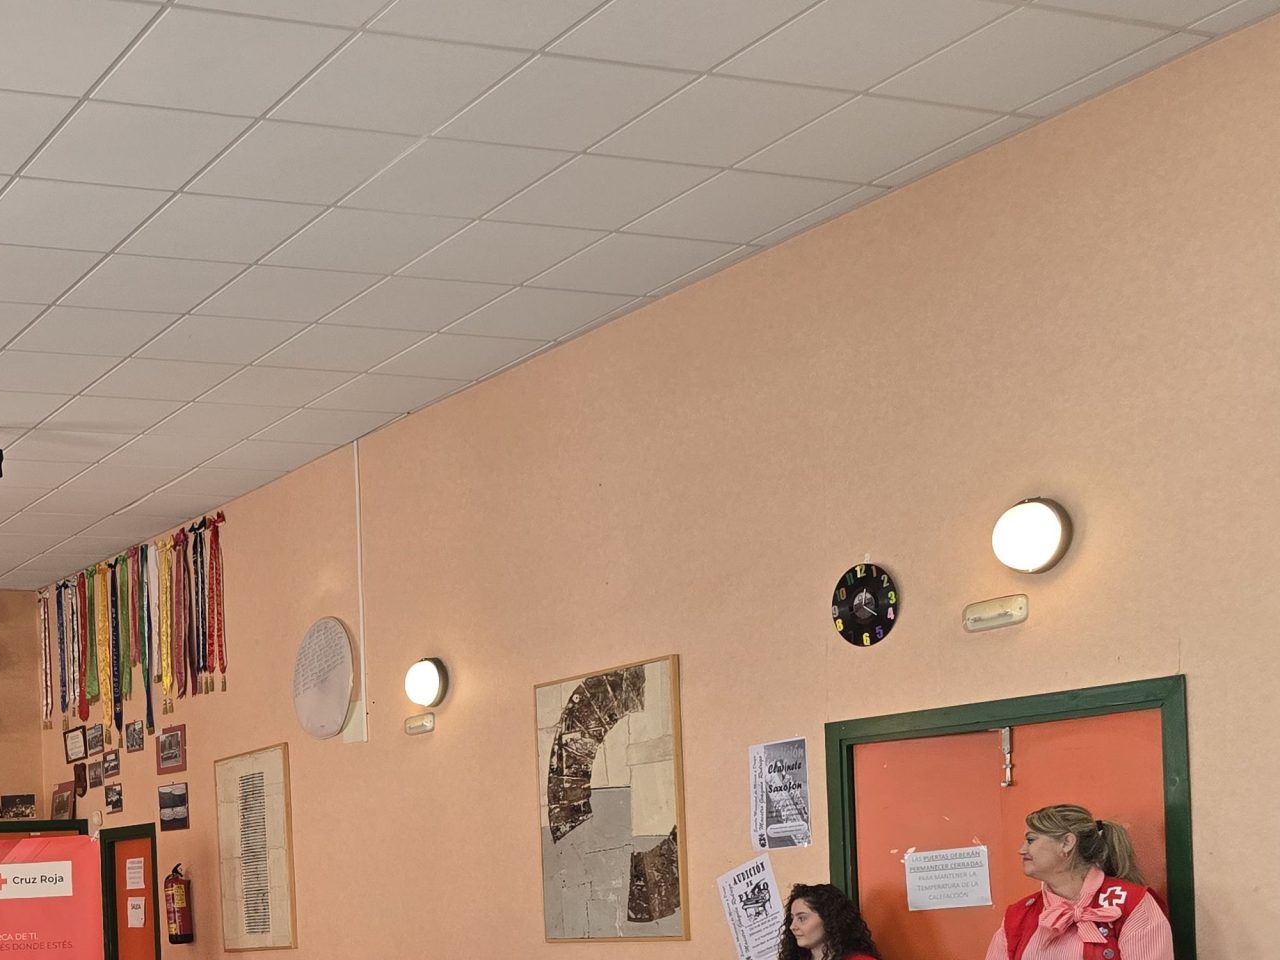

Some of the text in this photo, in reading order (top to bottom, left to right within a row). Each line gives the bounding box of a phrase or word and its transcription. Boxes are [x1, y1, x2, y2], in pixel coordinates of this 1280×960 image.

[855, 564, 866, 578] 12
[871, 566, 877, 578] 1
[845, 572, 855, 586] 11
[881, 574, 890, 588] 2
[835, 587, 847, 602] 10
[888, 591, 896, 604] 3
[832, 605, 839, 618] 9
[887, 607, 895, 620] 4
[835, 618, 844, 632] 8
[875, 625, 884, 639] 5
[862, 632, 871, 646] 6
[923, 854, 949, 862] PUERTAS
[950, 850, 981, 859] DEBERÁN
[733, 861, 766, 886] AUDICIÓN
[910, 861, 984, 873] PERMANECER CERRADAS
[12, 874, 64, 885] Cruz Roja
[934, 872, 967, 880] MANTENER
[917, 883, 960, 891] TEMPERATURA
[15, 932, 27, 941] DE
[12, 941, 45, 951] DONDE
[47, 940, 73, 950] ESTÉS
